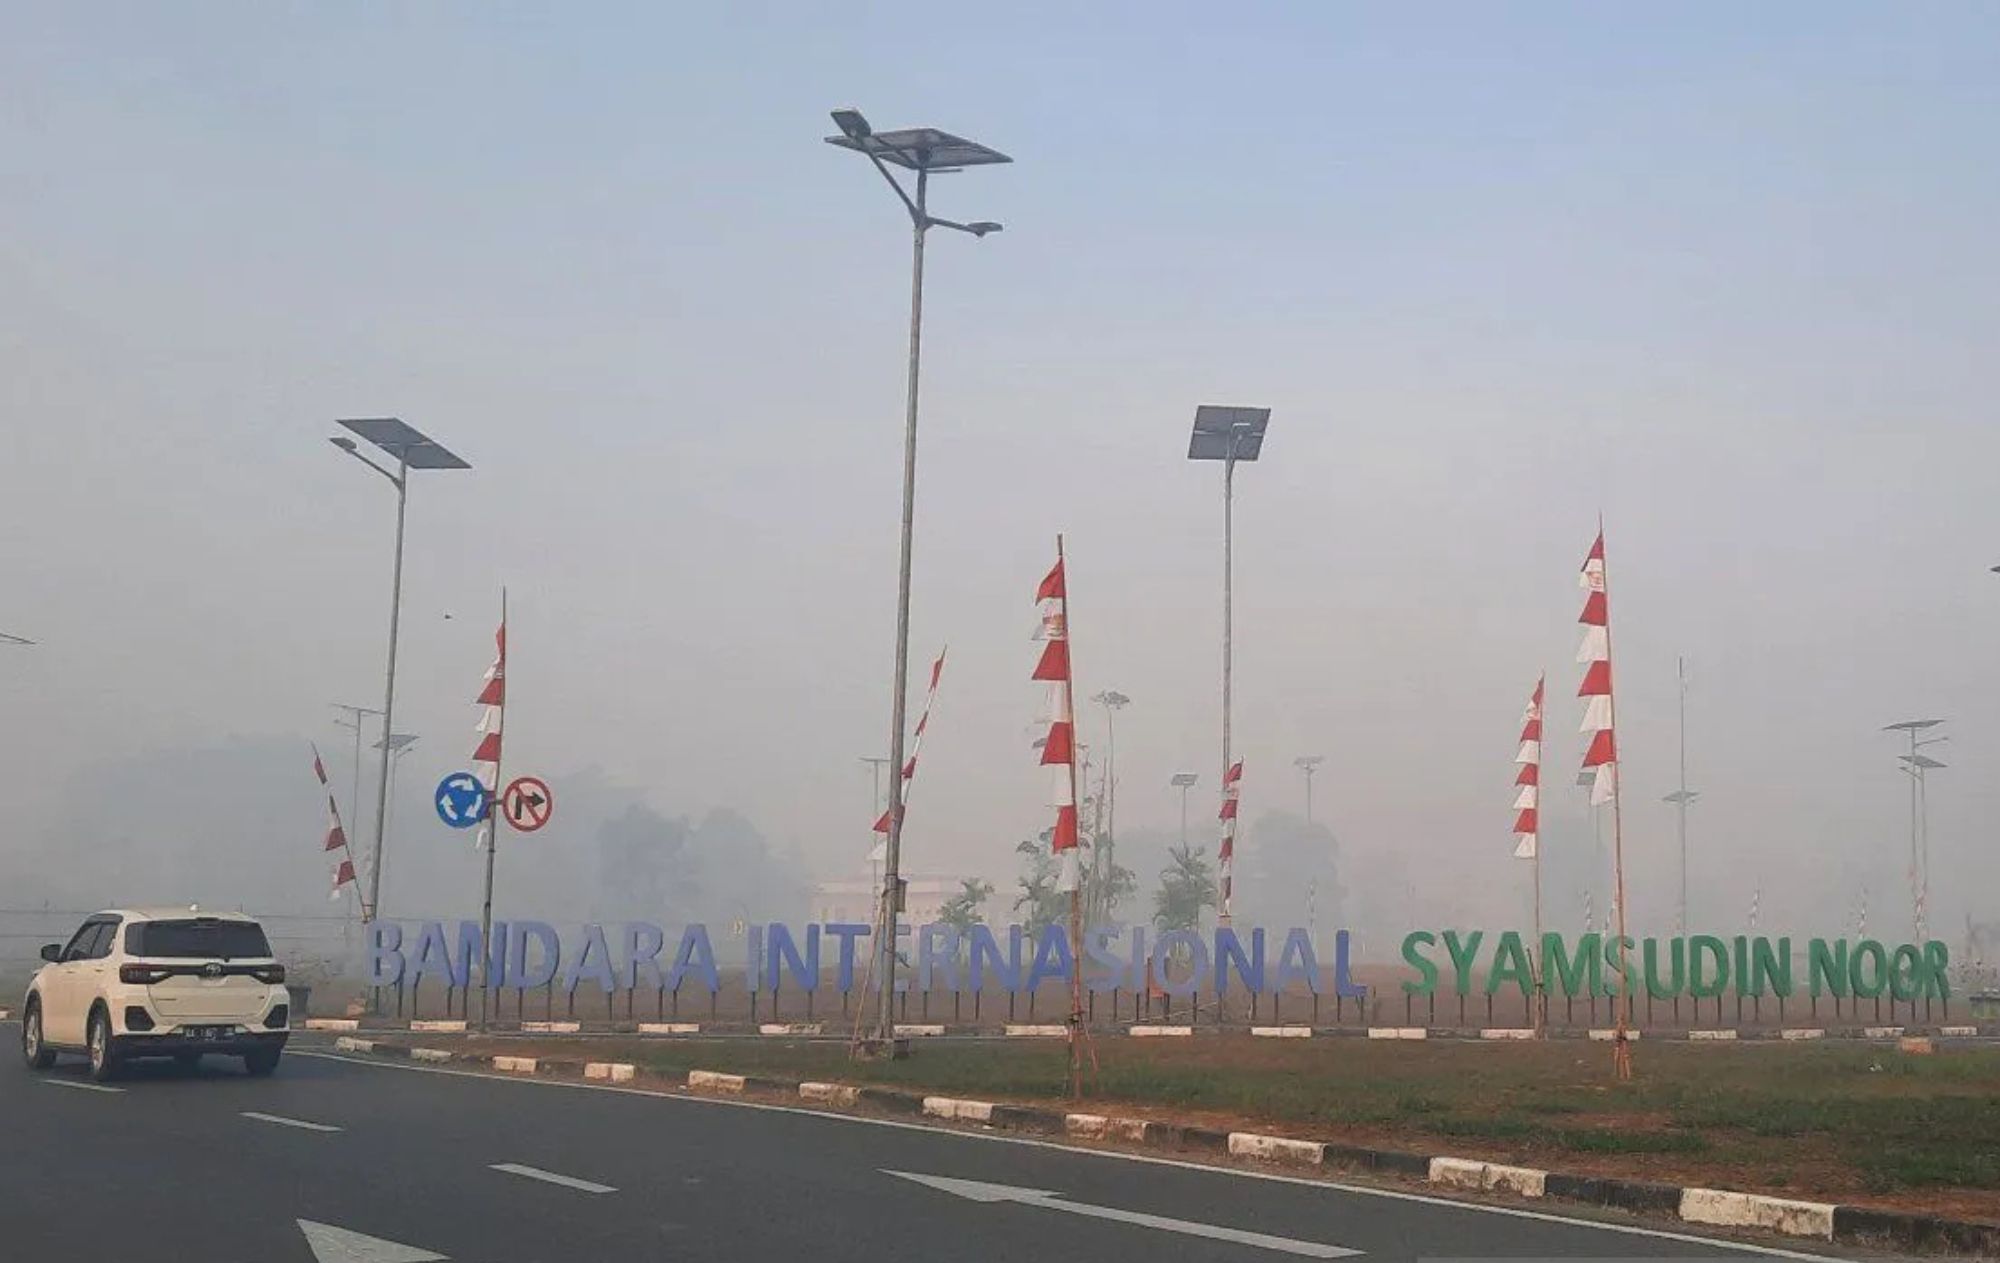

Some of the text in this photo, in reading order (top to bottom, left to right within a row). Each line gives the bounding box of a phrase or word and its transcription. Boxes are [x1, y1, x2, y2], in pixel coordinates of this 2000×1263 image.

[367, 920, 1950, 1001] BANDARA INTERNASIONAL SYAMSUDIN NOOR
